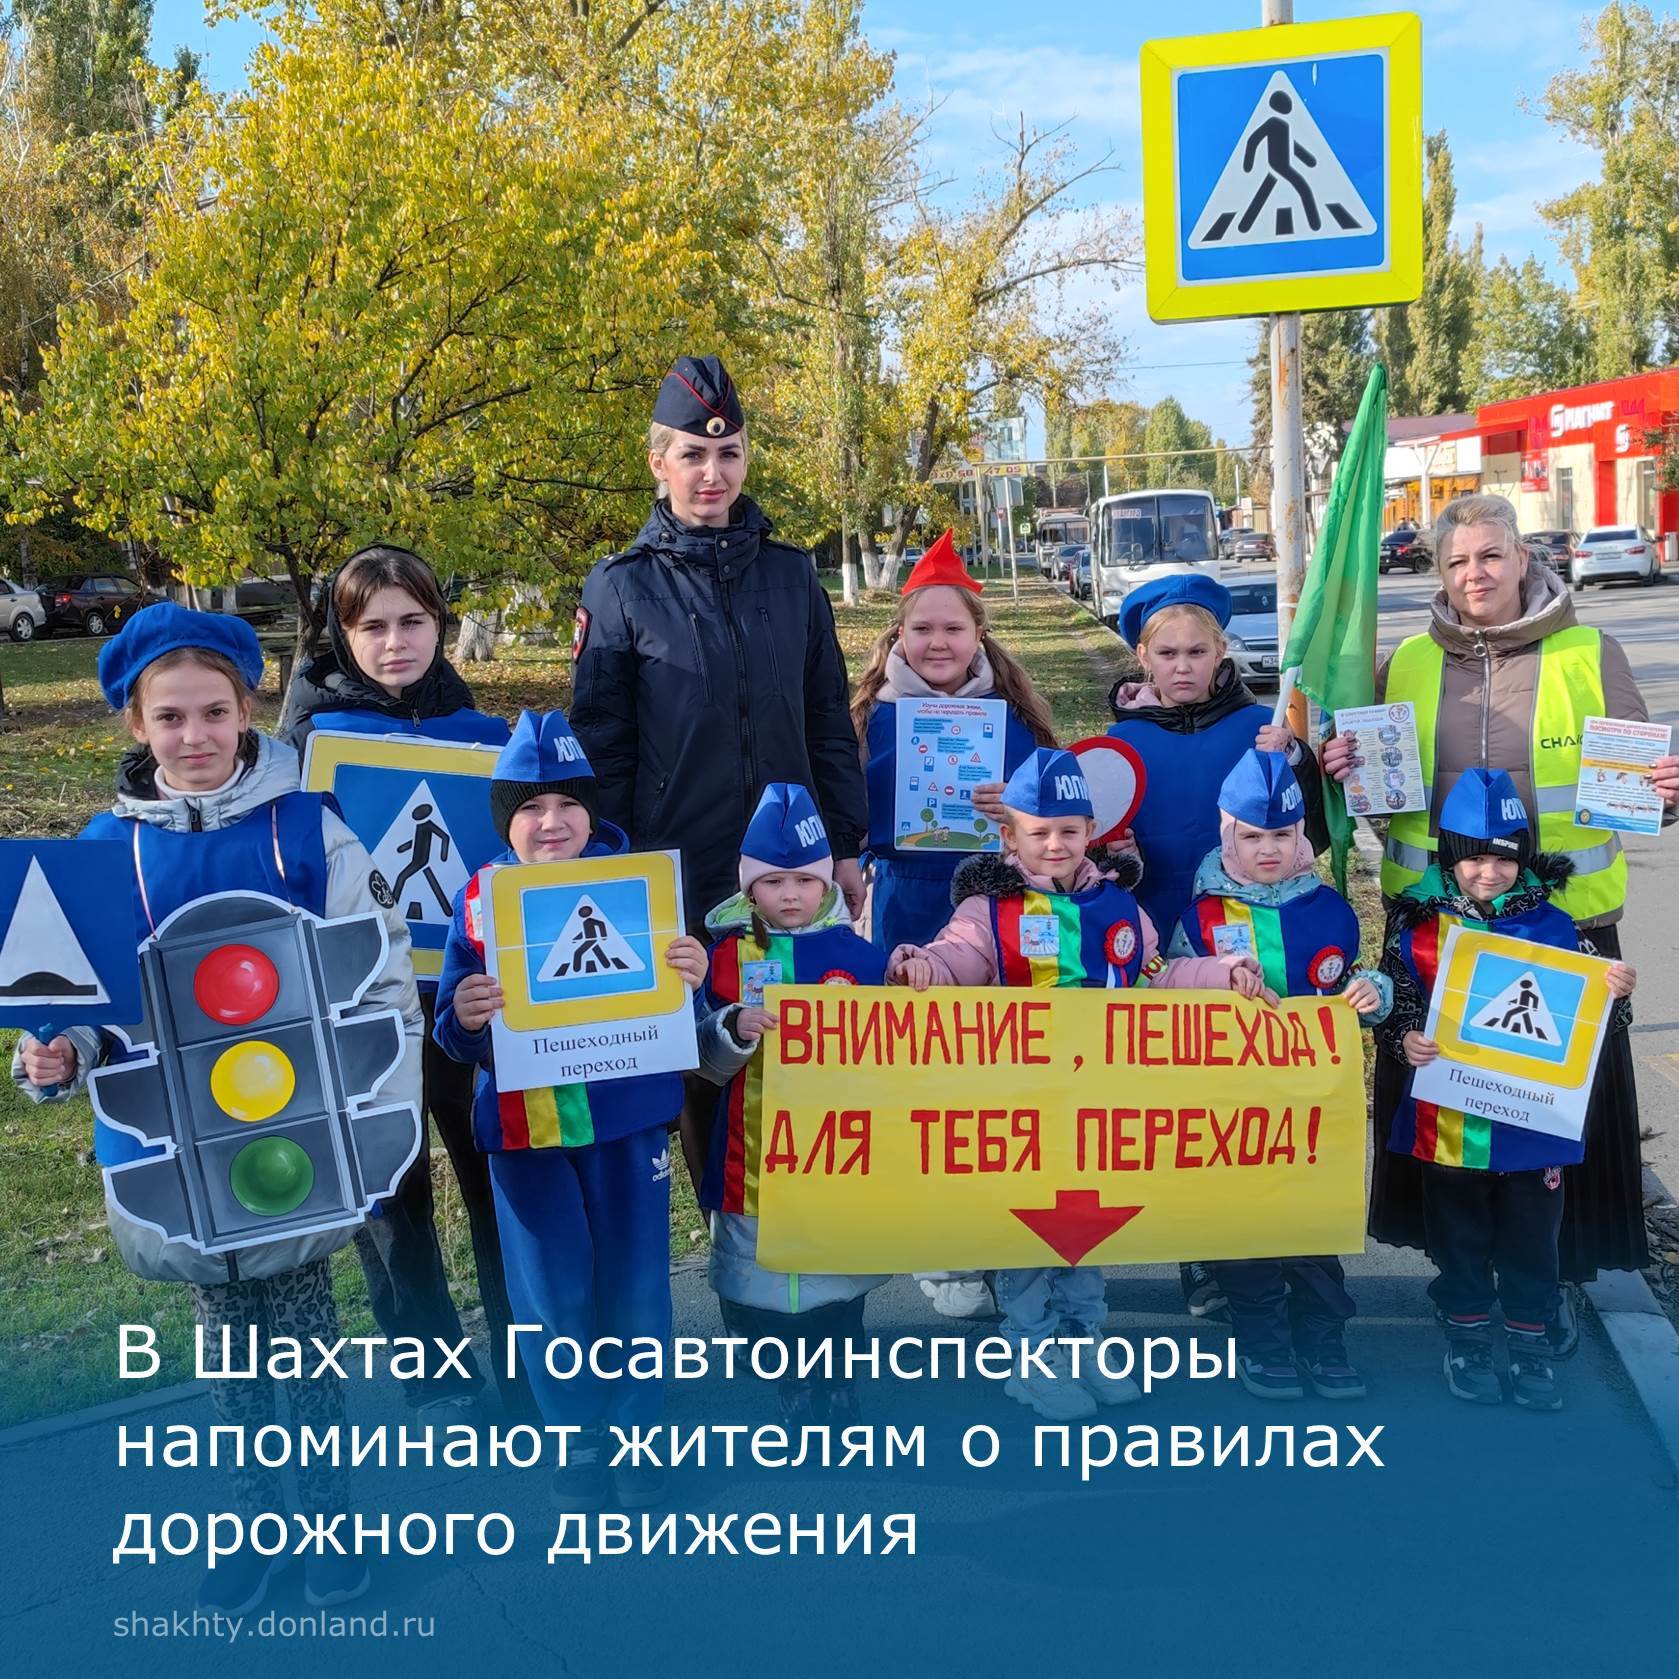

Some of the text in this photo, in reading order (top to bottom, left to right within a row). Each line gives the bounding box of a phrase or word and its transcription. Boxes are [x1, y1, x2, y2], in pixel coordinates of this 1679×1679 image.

[532, 1025, 659, 1055] Пешеходный
[1105, 1003, 1342, 1067] ПЕШЕХОД!
[560, 1057, 638, 1078] переход
[1449, 1068, 1555, 1106] Пешеходный
[1464, 1097, 1531, 1122] переход
[764, 1106, 1322, 1176] ДЛЯ ТЕБЯ ПЕРЕХОД!
